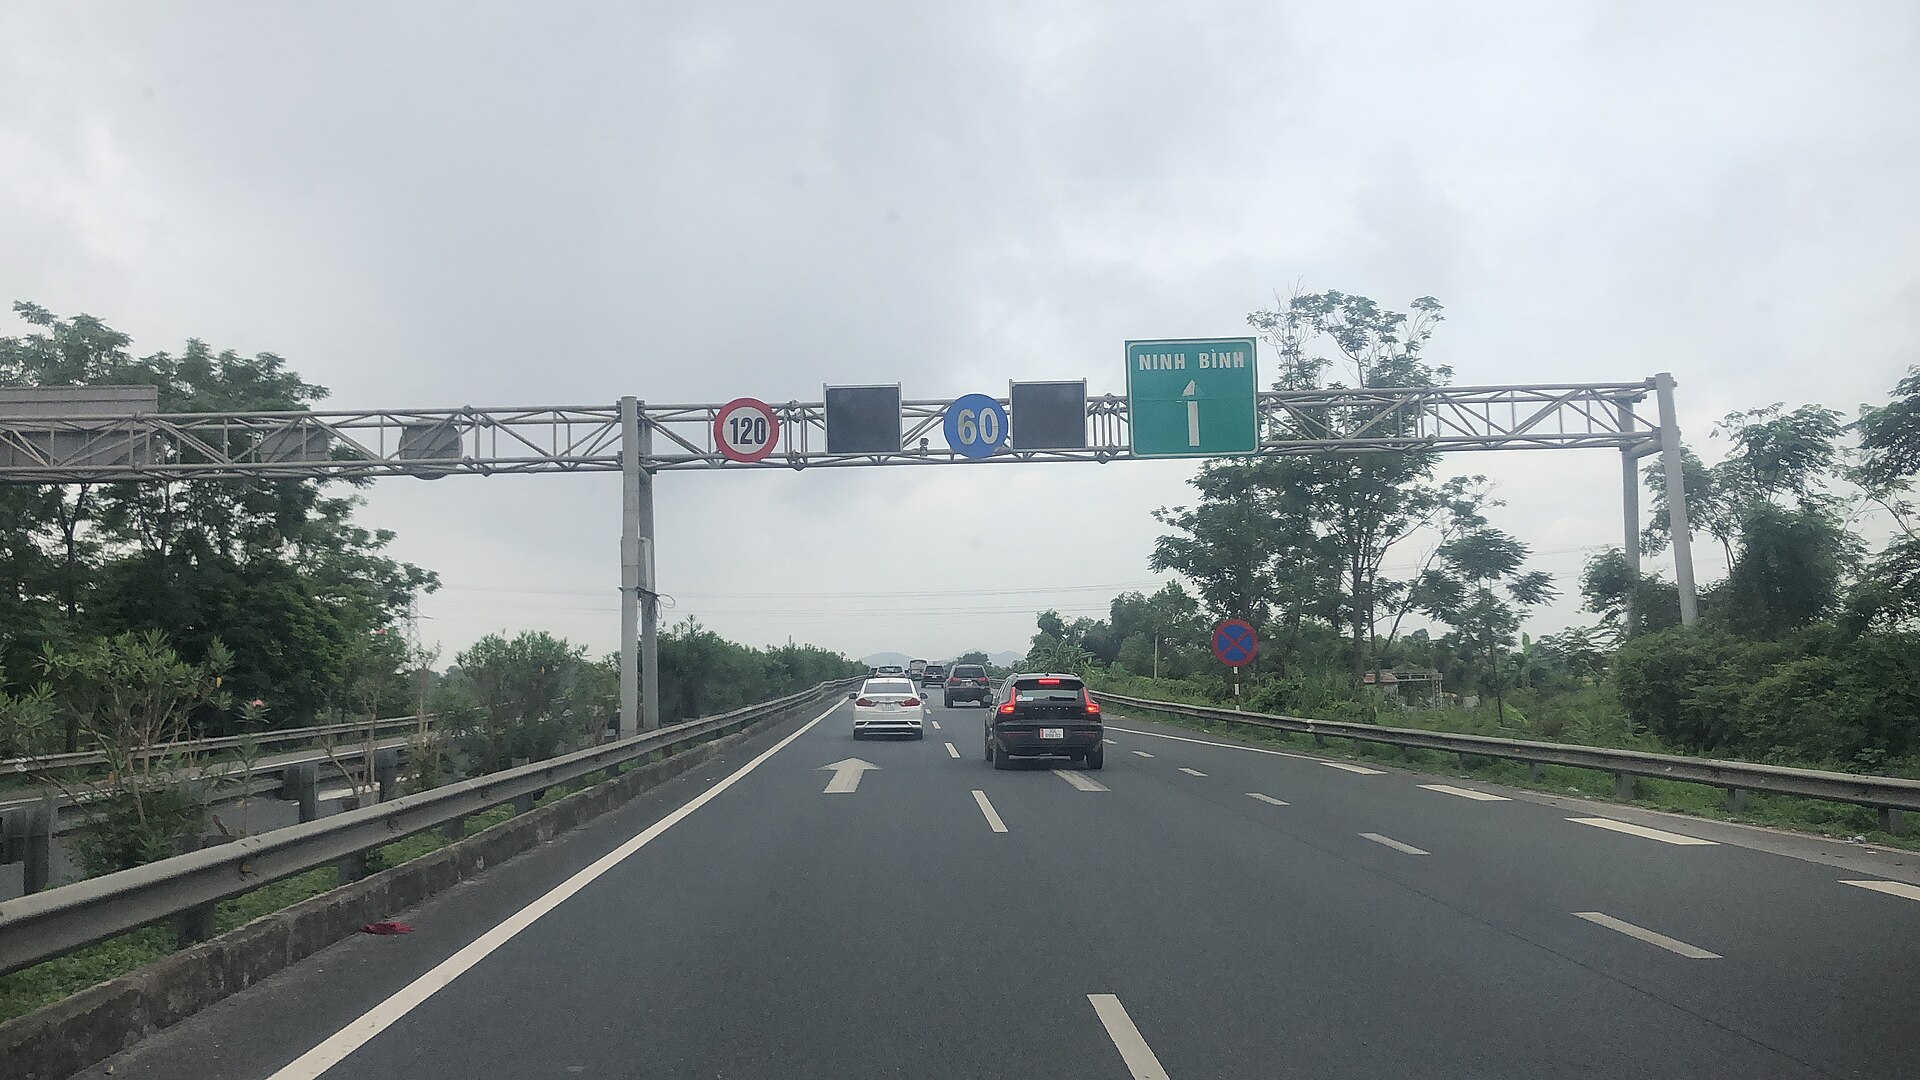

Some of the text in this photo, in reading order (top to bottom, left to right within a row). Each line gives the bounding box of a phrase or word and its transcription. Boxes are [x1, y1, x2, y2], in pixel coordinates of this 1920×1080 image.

[1138, 349, 1245, 371] NINH BÌNH
[729, 417, 767, 445] 120
[957, 407, 999, 446] 60
